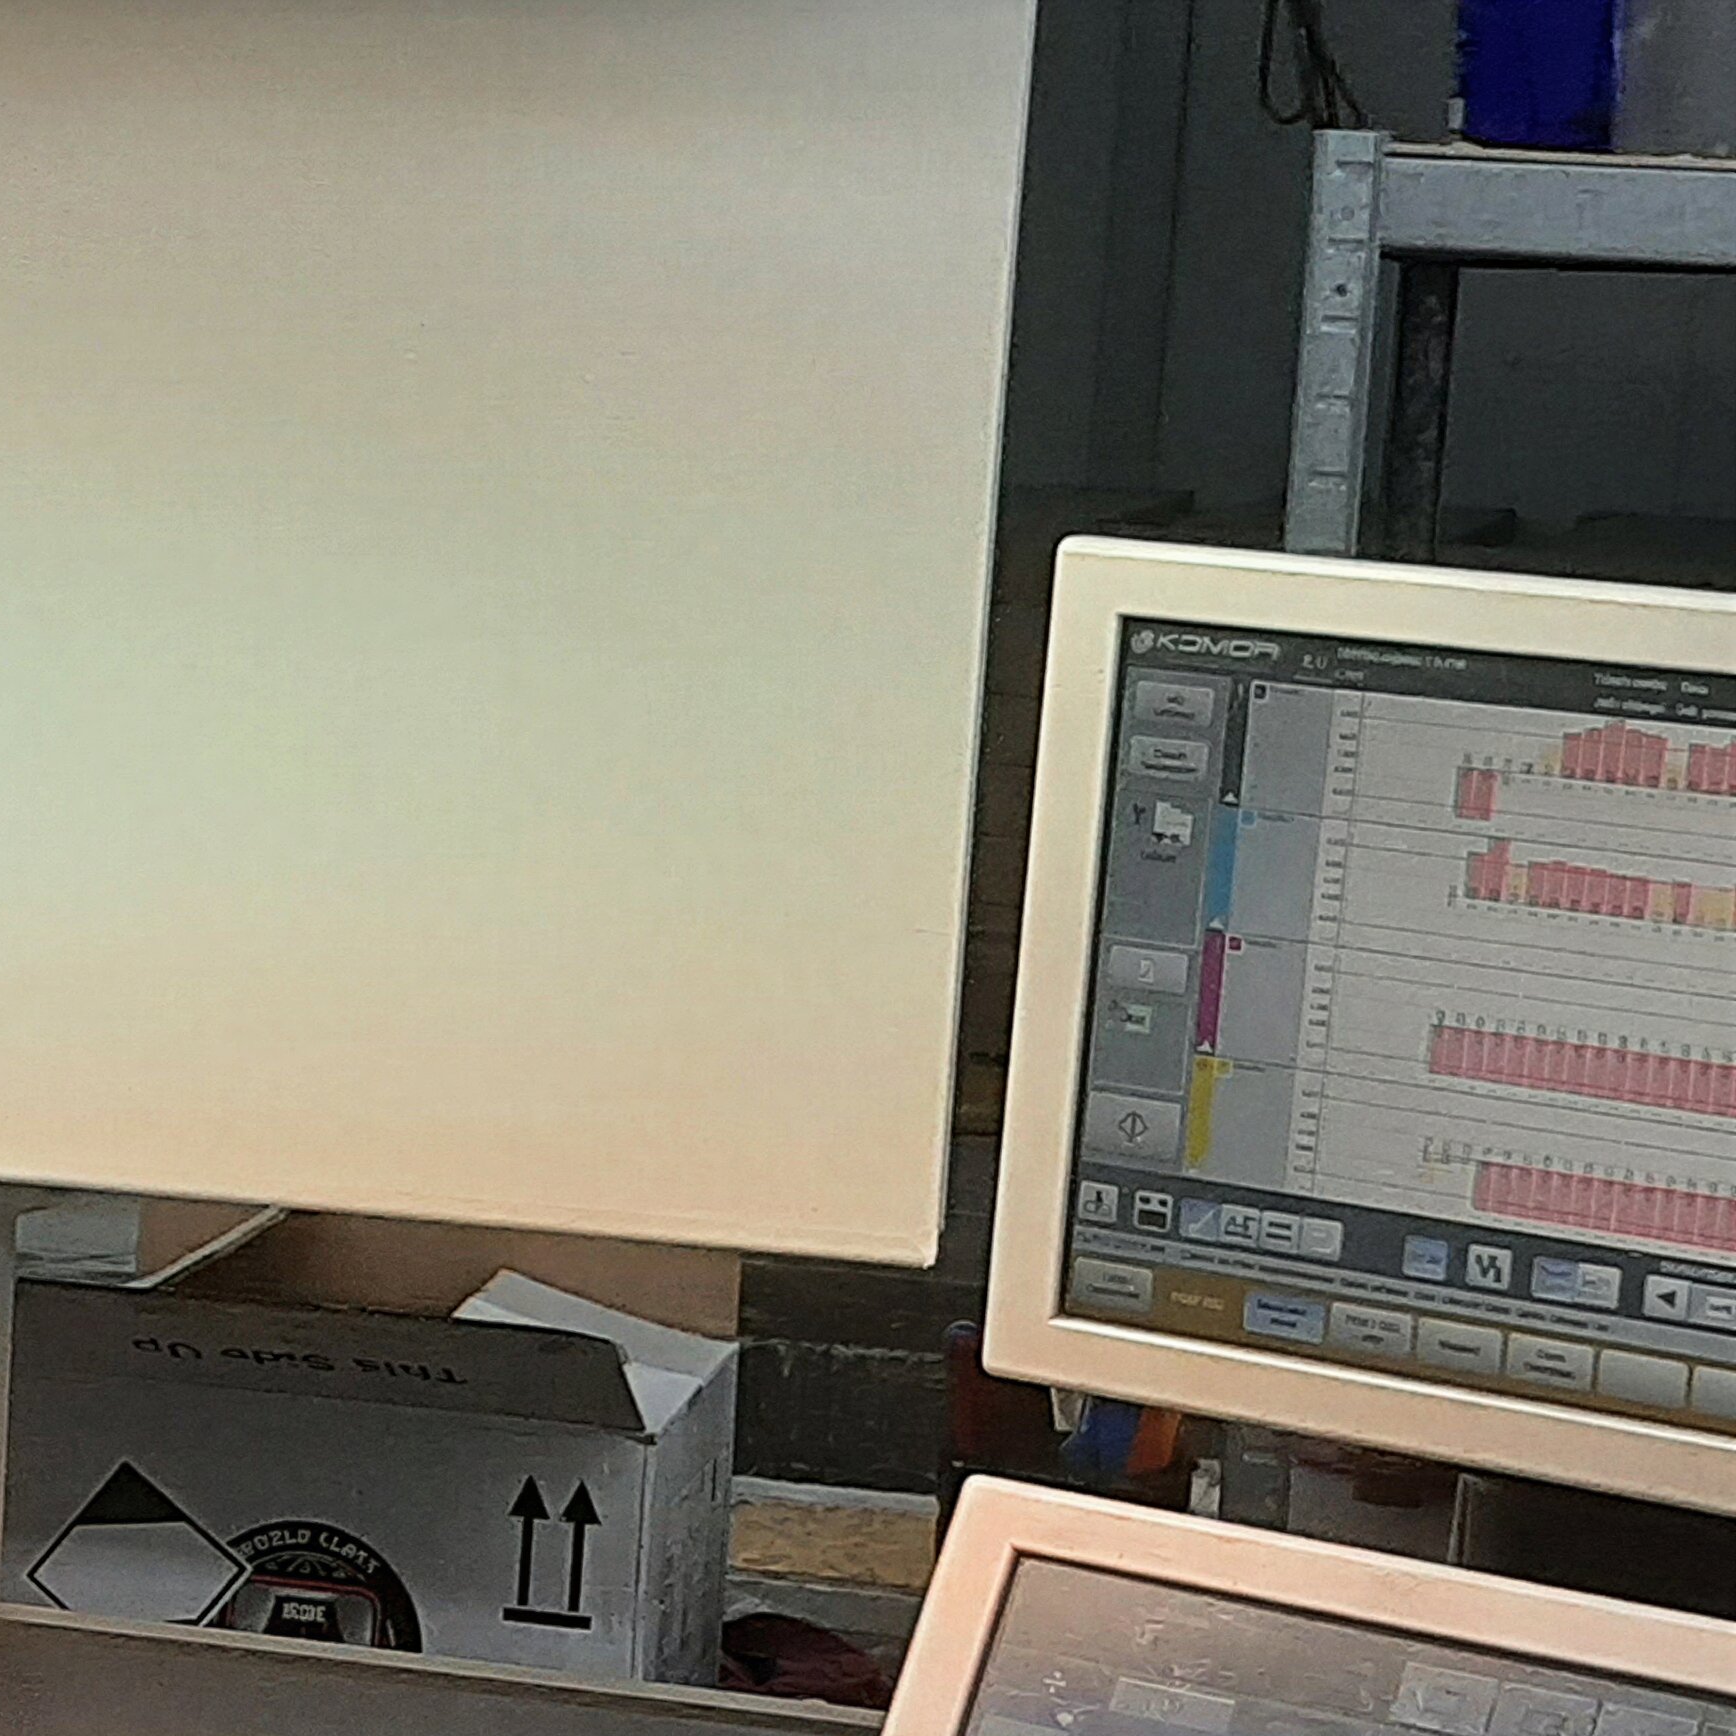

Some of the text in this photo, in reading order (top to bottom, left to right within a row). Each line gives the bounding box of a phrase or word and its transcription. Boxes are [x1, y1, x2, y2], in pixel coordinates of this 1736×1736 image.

[132, 1337, 468, 1384] This Side Up
